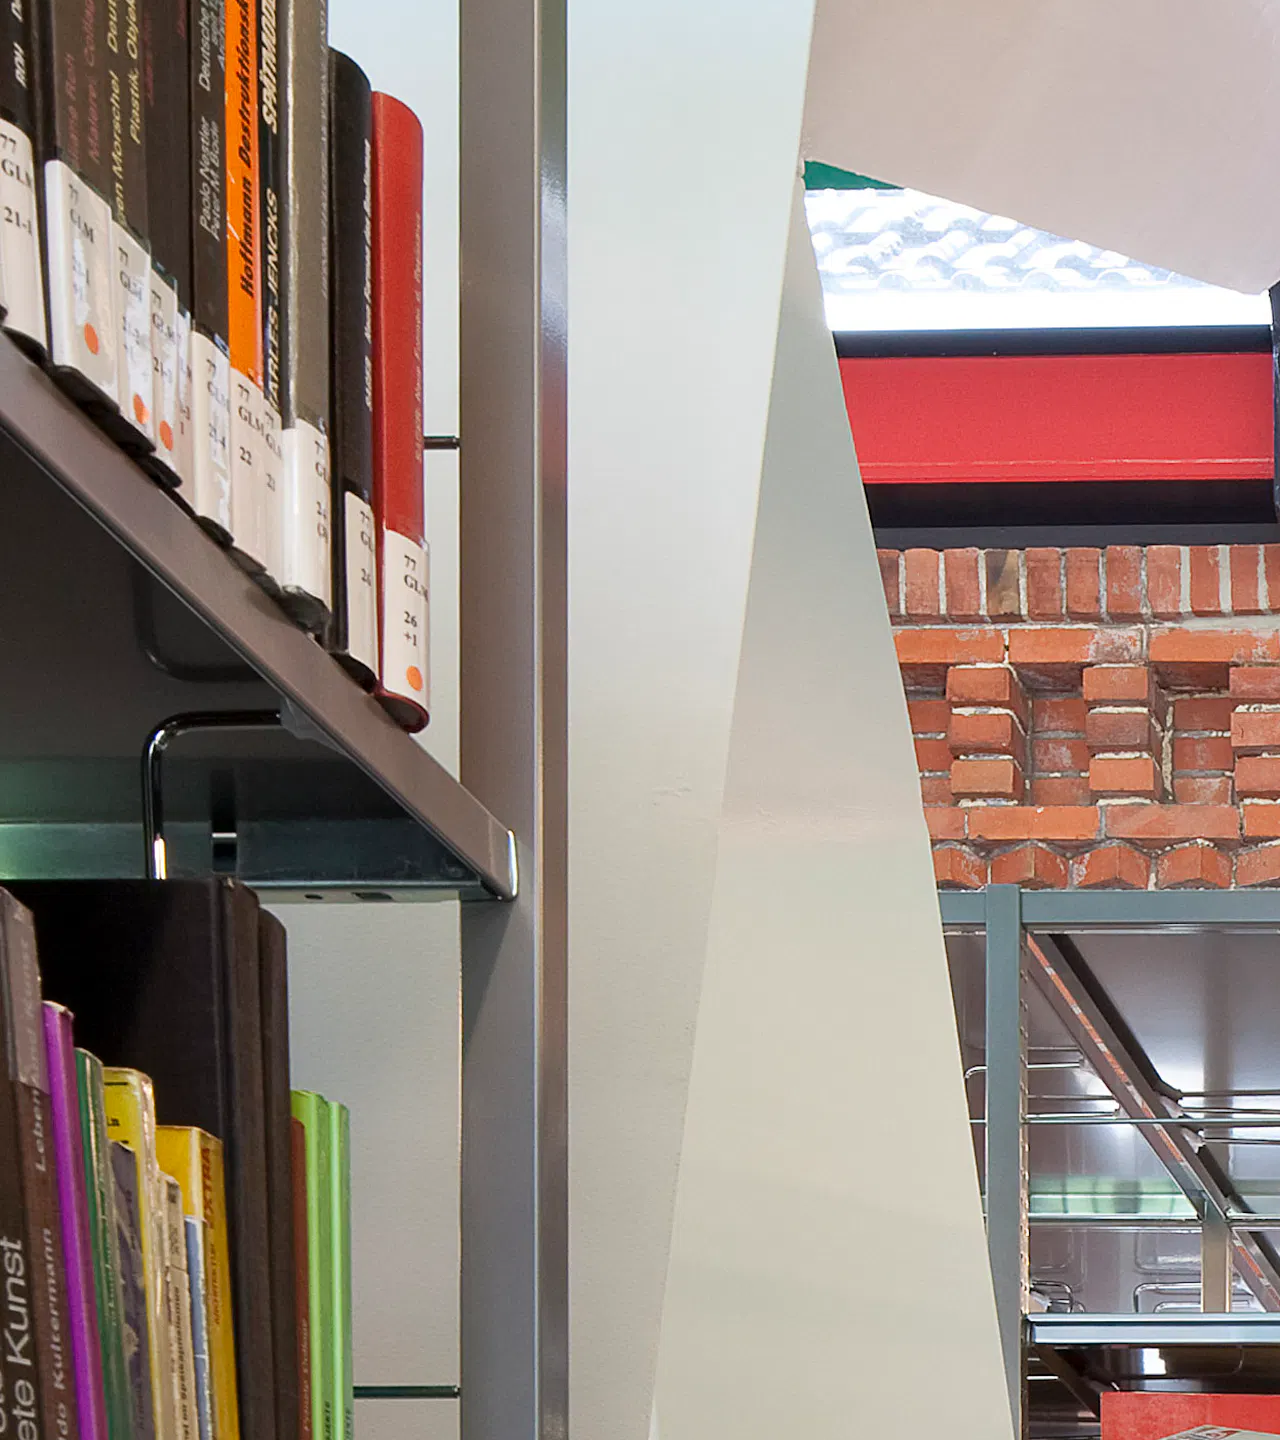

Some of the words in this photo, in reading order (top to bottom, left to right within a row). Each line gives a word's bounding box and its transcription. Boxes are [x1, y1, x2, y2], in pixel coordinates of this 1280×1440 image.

[198, 7, 212, 92] Deutsche
[1, 135, 19, 152] 77
[108, 69, 126, 176] Morschel
[198, 181, 214, 231] Paolo
[239, 176, 255, 296] Hoffmann
[263, 187, 279, 308] JENCKS
[238, 383, 252, 401] 77
[240, 447, 252, 465] 22
[404, 554, 417, 572] 77
[404, 611, 417, 628] 26
[30, 1081, 49, 1173] Leben
[1, 1238, 33, 1366] Kunst
[42, 1227, 66, 1392] Kultermann
